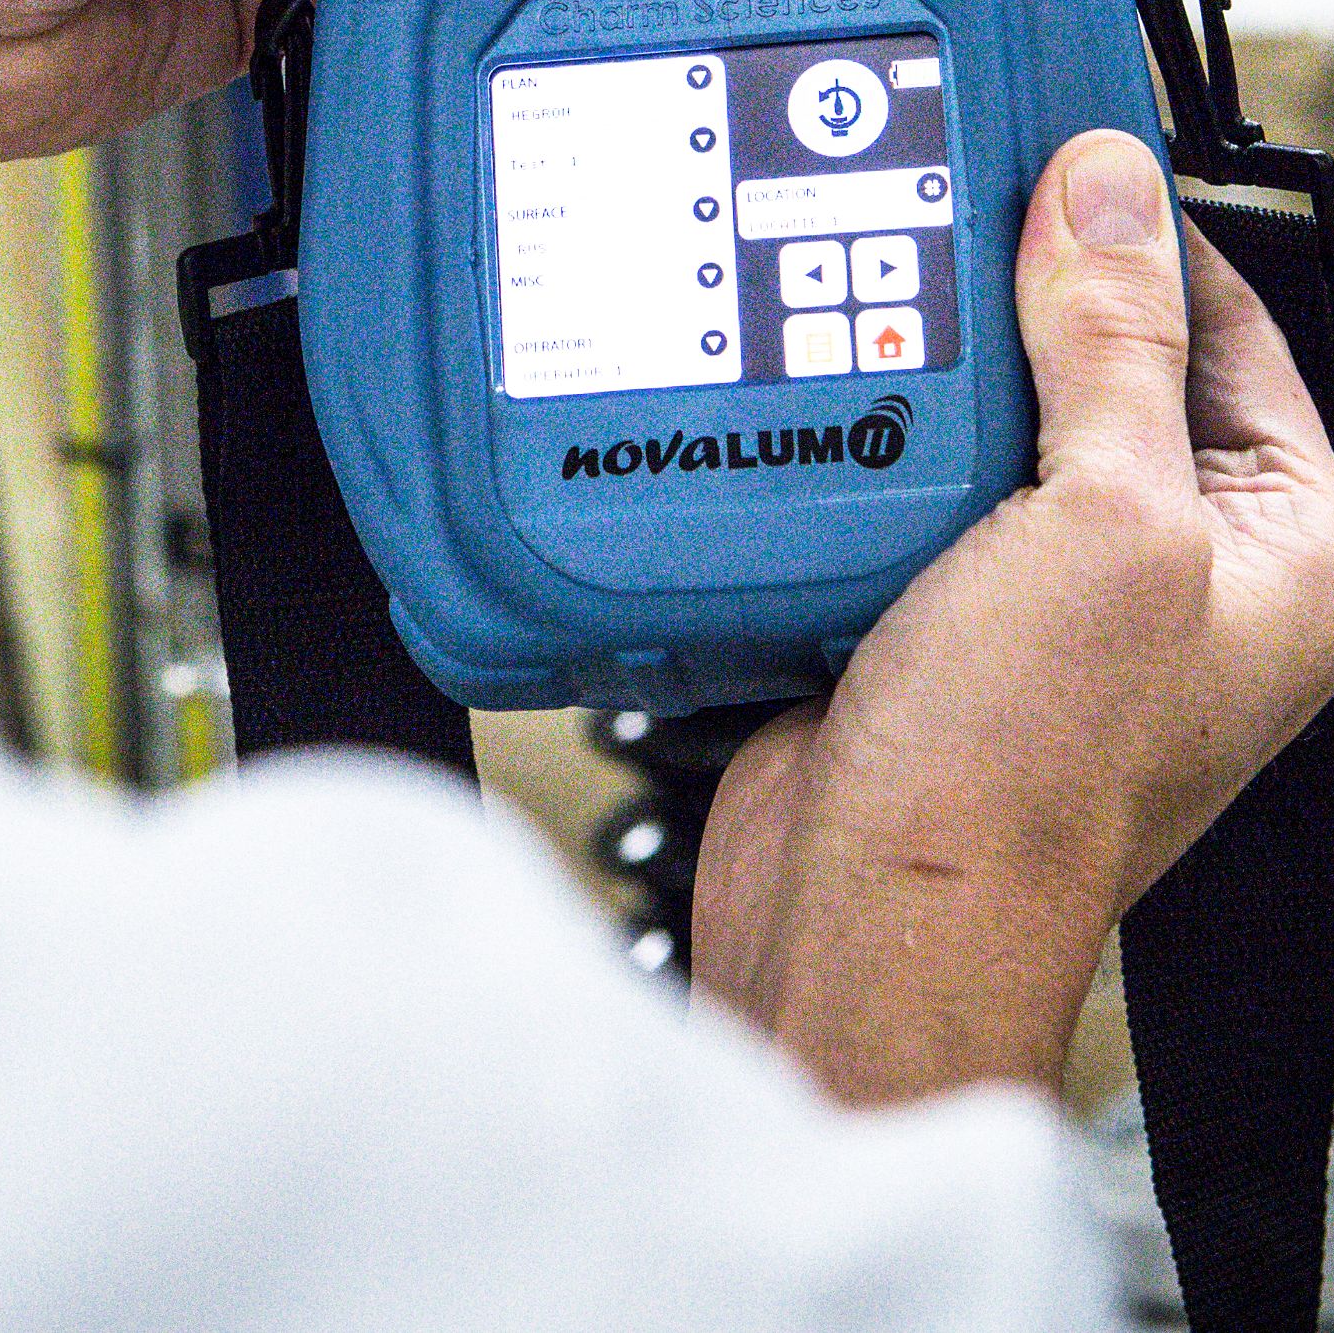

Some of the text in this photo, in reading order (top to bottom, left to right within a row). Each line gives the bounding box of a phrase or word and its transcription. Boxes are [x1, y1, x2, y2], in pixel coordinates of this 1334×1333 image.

[539, 0, 679, 37] Charm
[501, 77, 537, 90] PLAN
[746, 187, 817, 203] LOCATION
[507, 206, 567, 222] SURFACE
[510, 275, 544, 287] MISC
